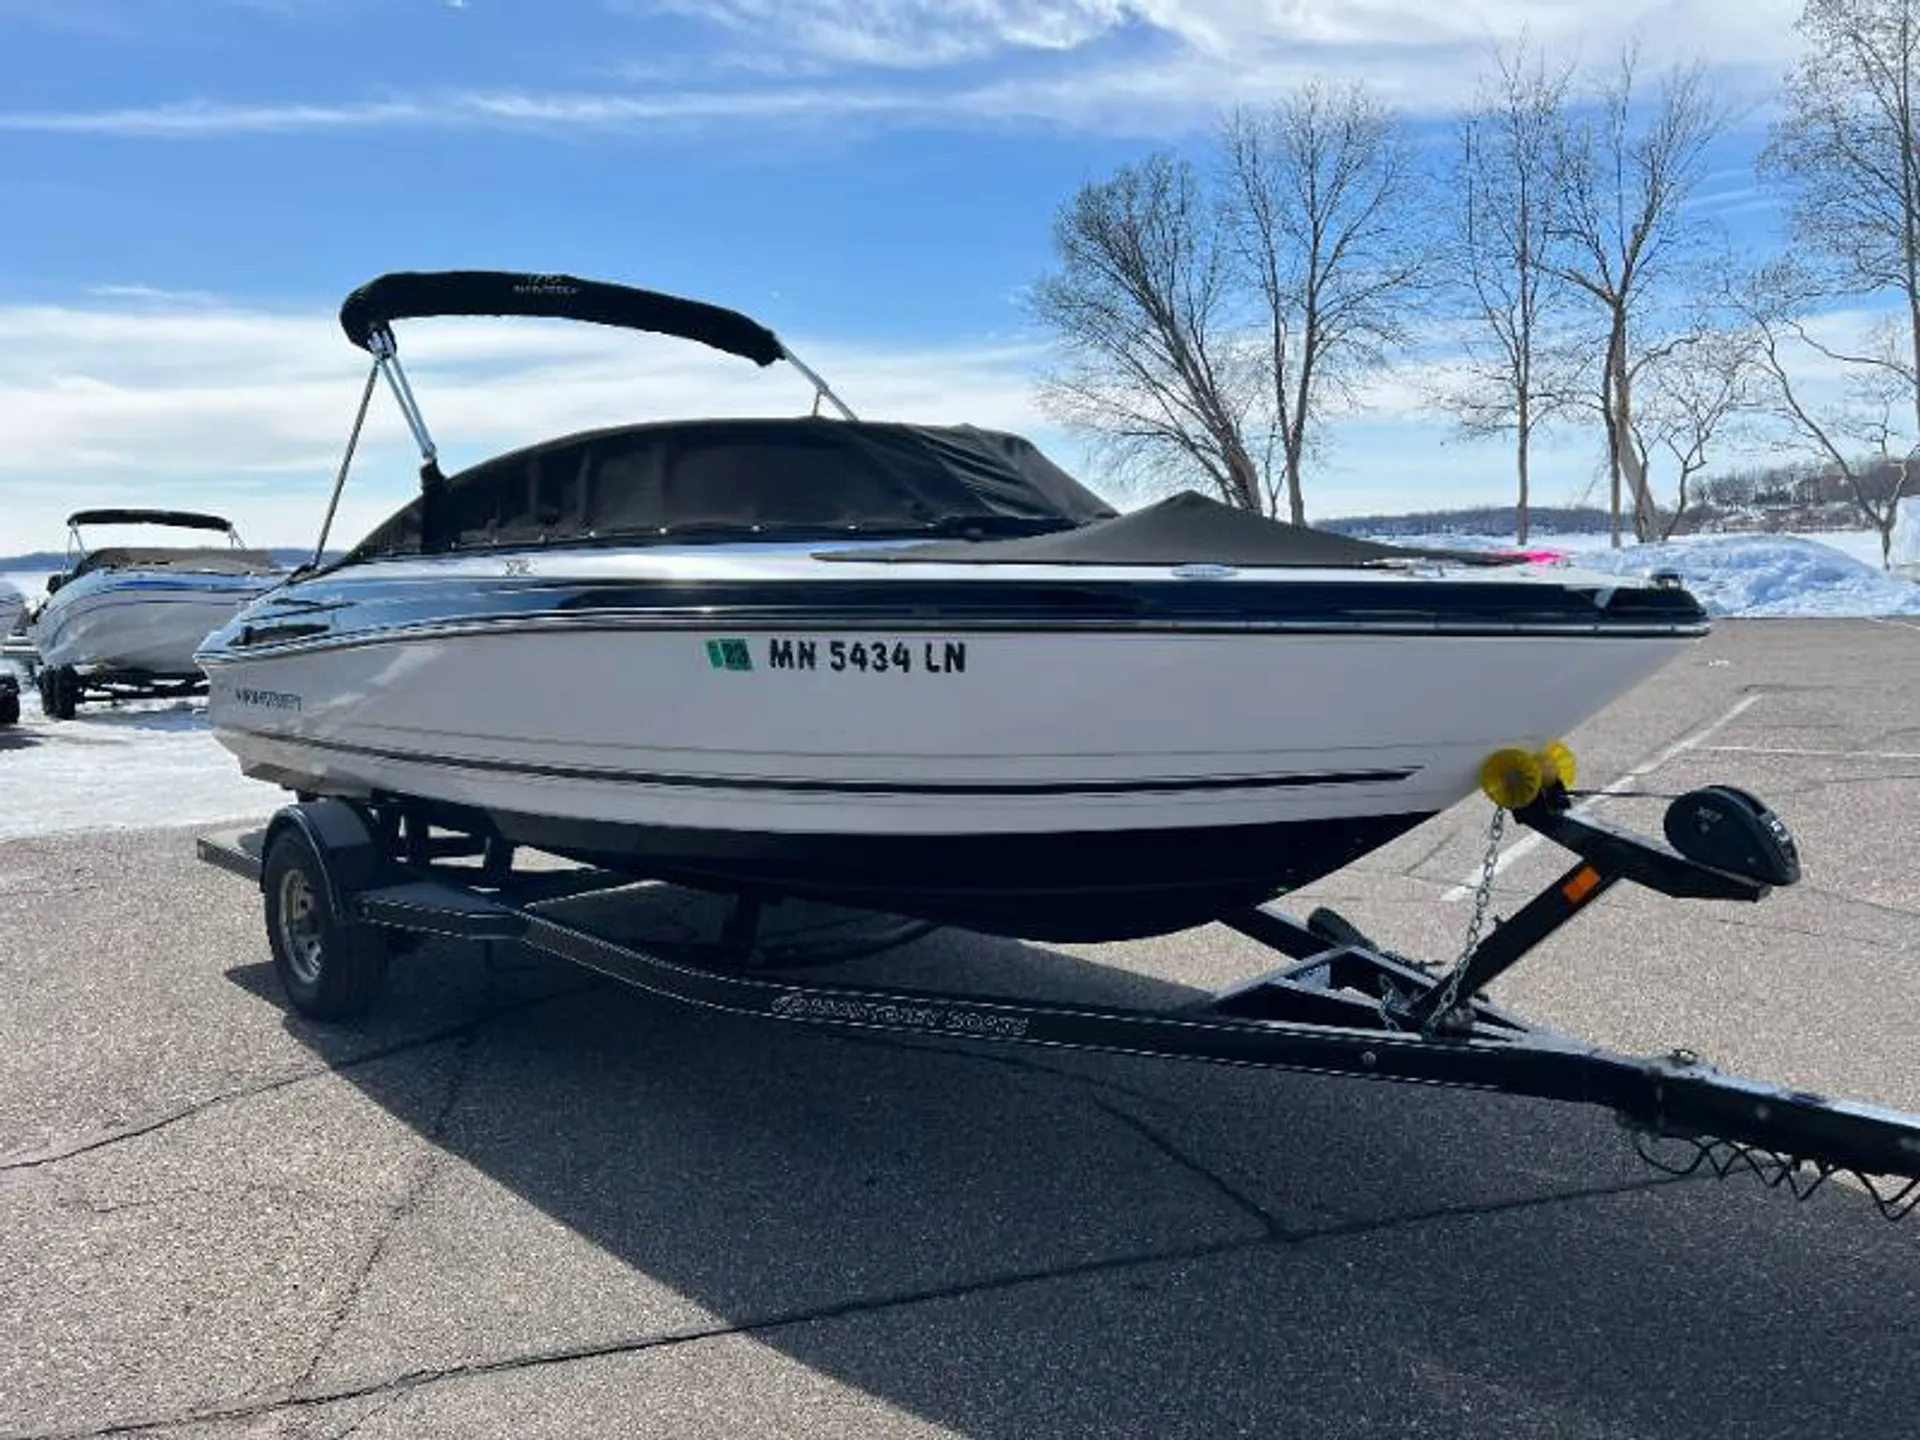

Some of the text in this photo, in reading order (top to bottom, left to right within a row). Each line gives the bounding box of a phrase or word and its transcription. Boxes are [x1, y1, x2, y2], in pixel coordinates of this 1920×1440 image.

[769, 638, 967, 673] MN 5434 LN
